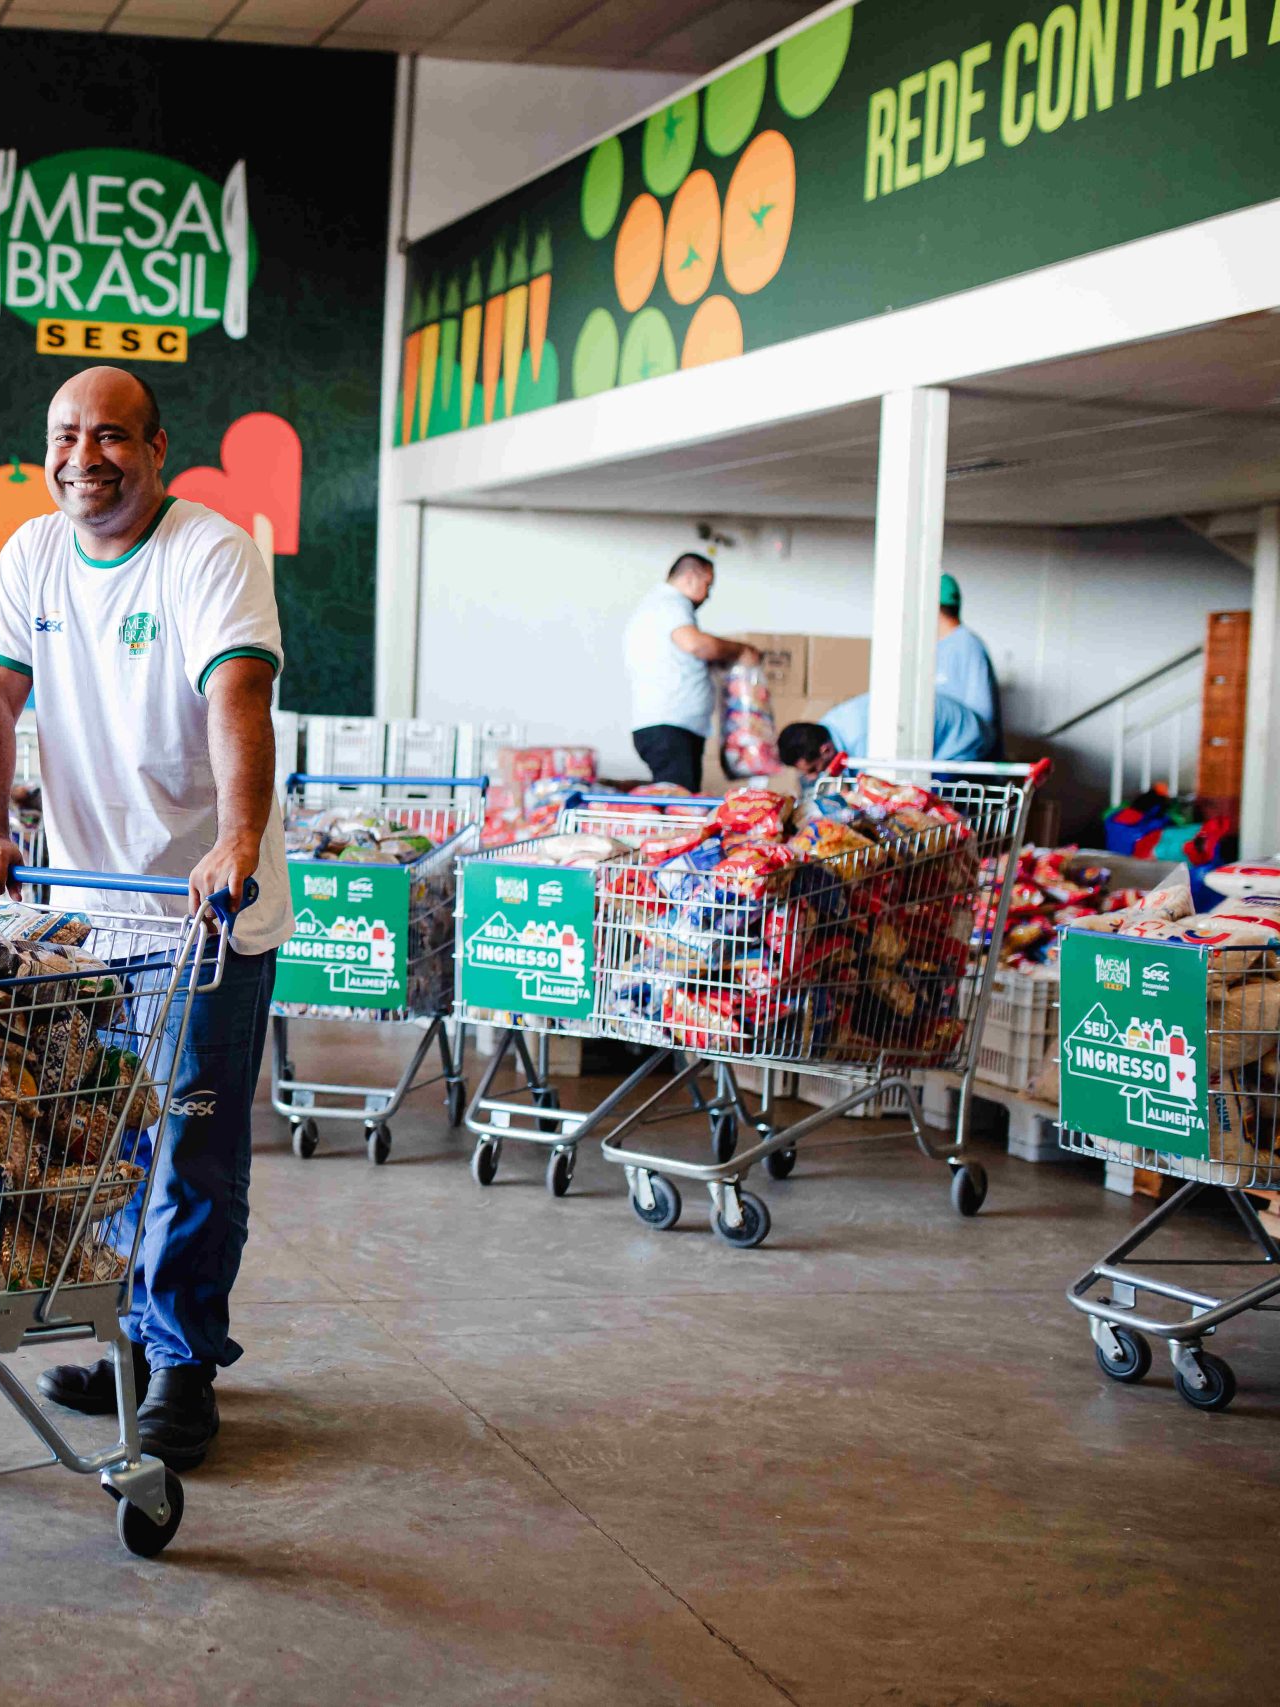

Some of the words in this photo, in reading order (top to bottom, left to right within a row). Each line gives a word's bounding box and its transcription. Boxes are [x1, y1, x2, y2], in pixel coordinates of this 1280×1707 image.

[865, 42, 992, 202] REDE
[9, 169, 222, 253] MESA
[5, 241, 221, 318] BRASIL
[46, 324, 179, 354] SESC
[35, 617, 64, 632] Sesc
[484, 925, 508, 938] SEU
[283, 941, 369, 961] INGRESSO
[476, 944, 559, 968] INGRESSO
[349, 977, 400, 989] ALIMENTA
[1142, 967, 1170, 982] Sesc
[540, 984, 590, 1000] ALIMENTA
[1084, 1020, 1109, 1039] SEU
[1076, 1046, 1167, 1083] INGRESSO
[169, 1098, 217, 1117] Sesc
[1147, 1107, 1205, 1130] ALIMENTA
